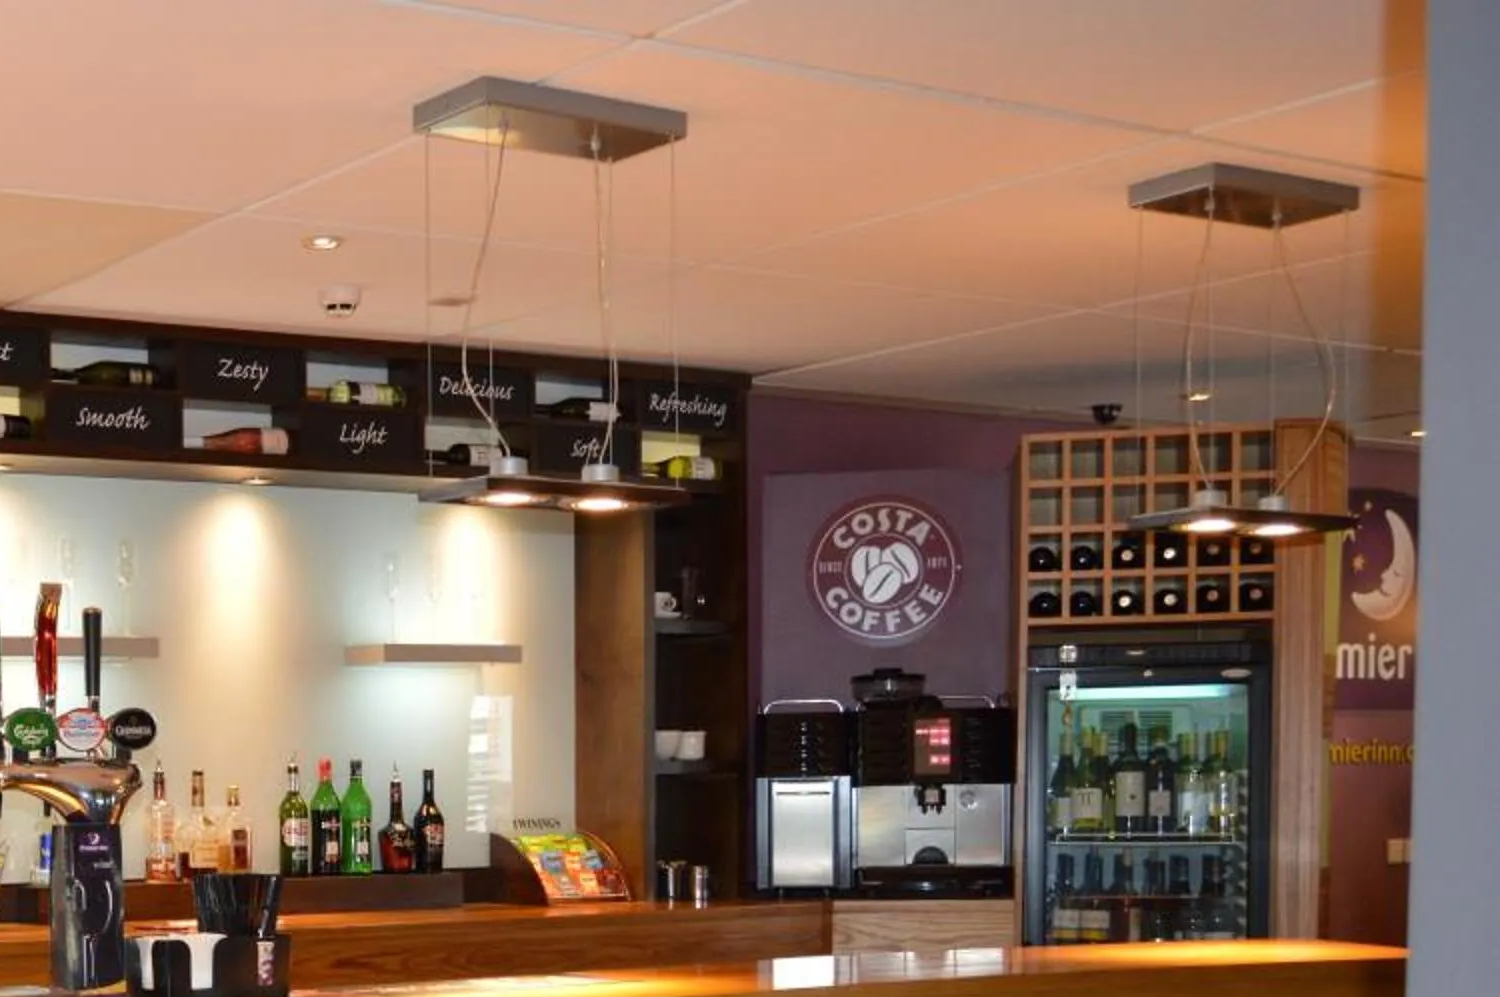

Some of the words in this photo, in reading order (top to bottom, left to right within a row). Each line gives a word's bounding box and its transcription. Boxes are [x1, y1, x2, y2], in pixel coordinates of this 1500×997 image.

[218, 358, 269, 391] Zesty
[439, 376, 514, 400] Delicious
[76, 407, 151, 431] Smooth
[649, 393, 727, 426] Refreshing
[339, 422, 388, 454] Light
[571, 438, 601, 464] Soft
[832, 508, 931, 549] COSTA
[825, 584, 943, 632] COFFEE
[1336, 632, 1413, 679] mier
